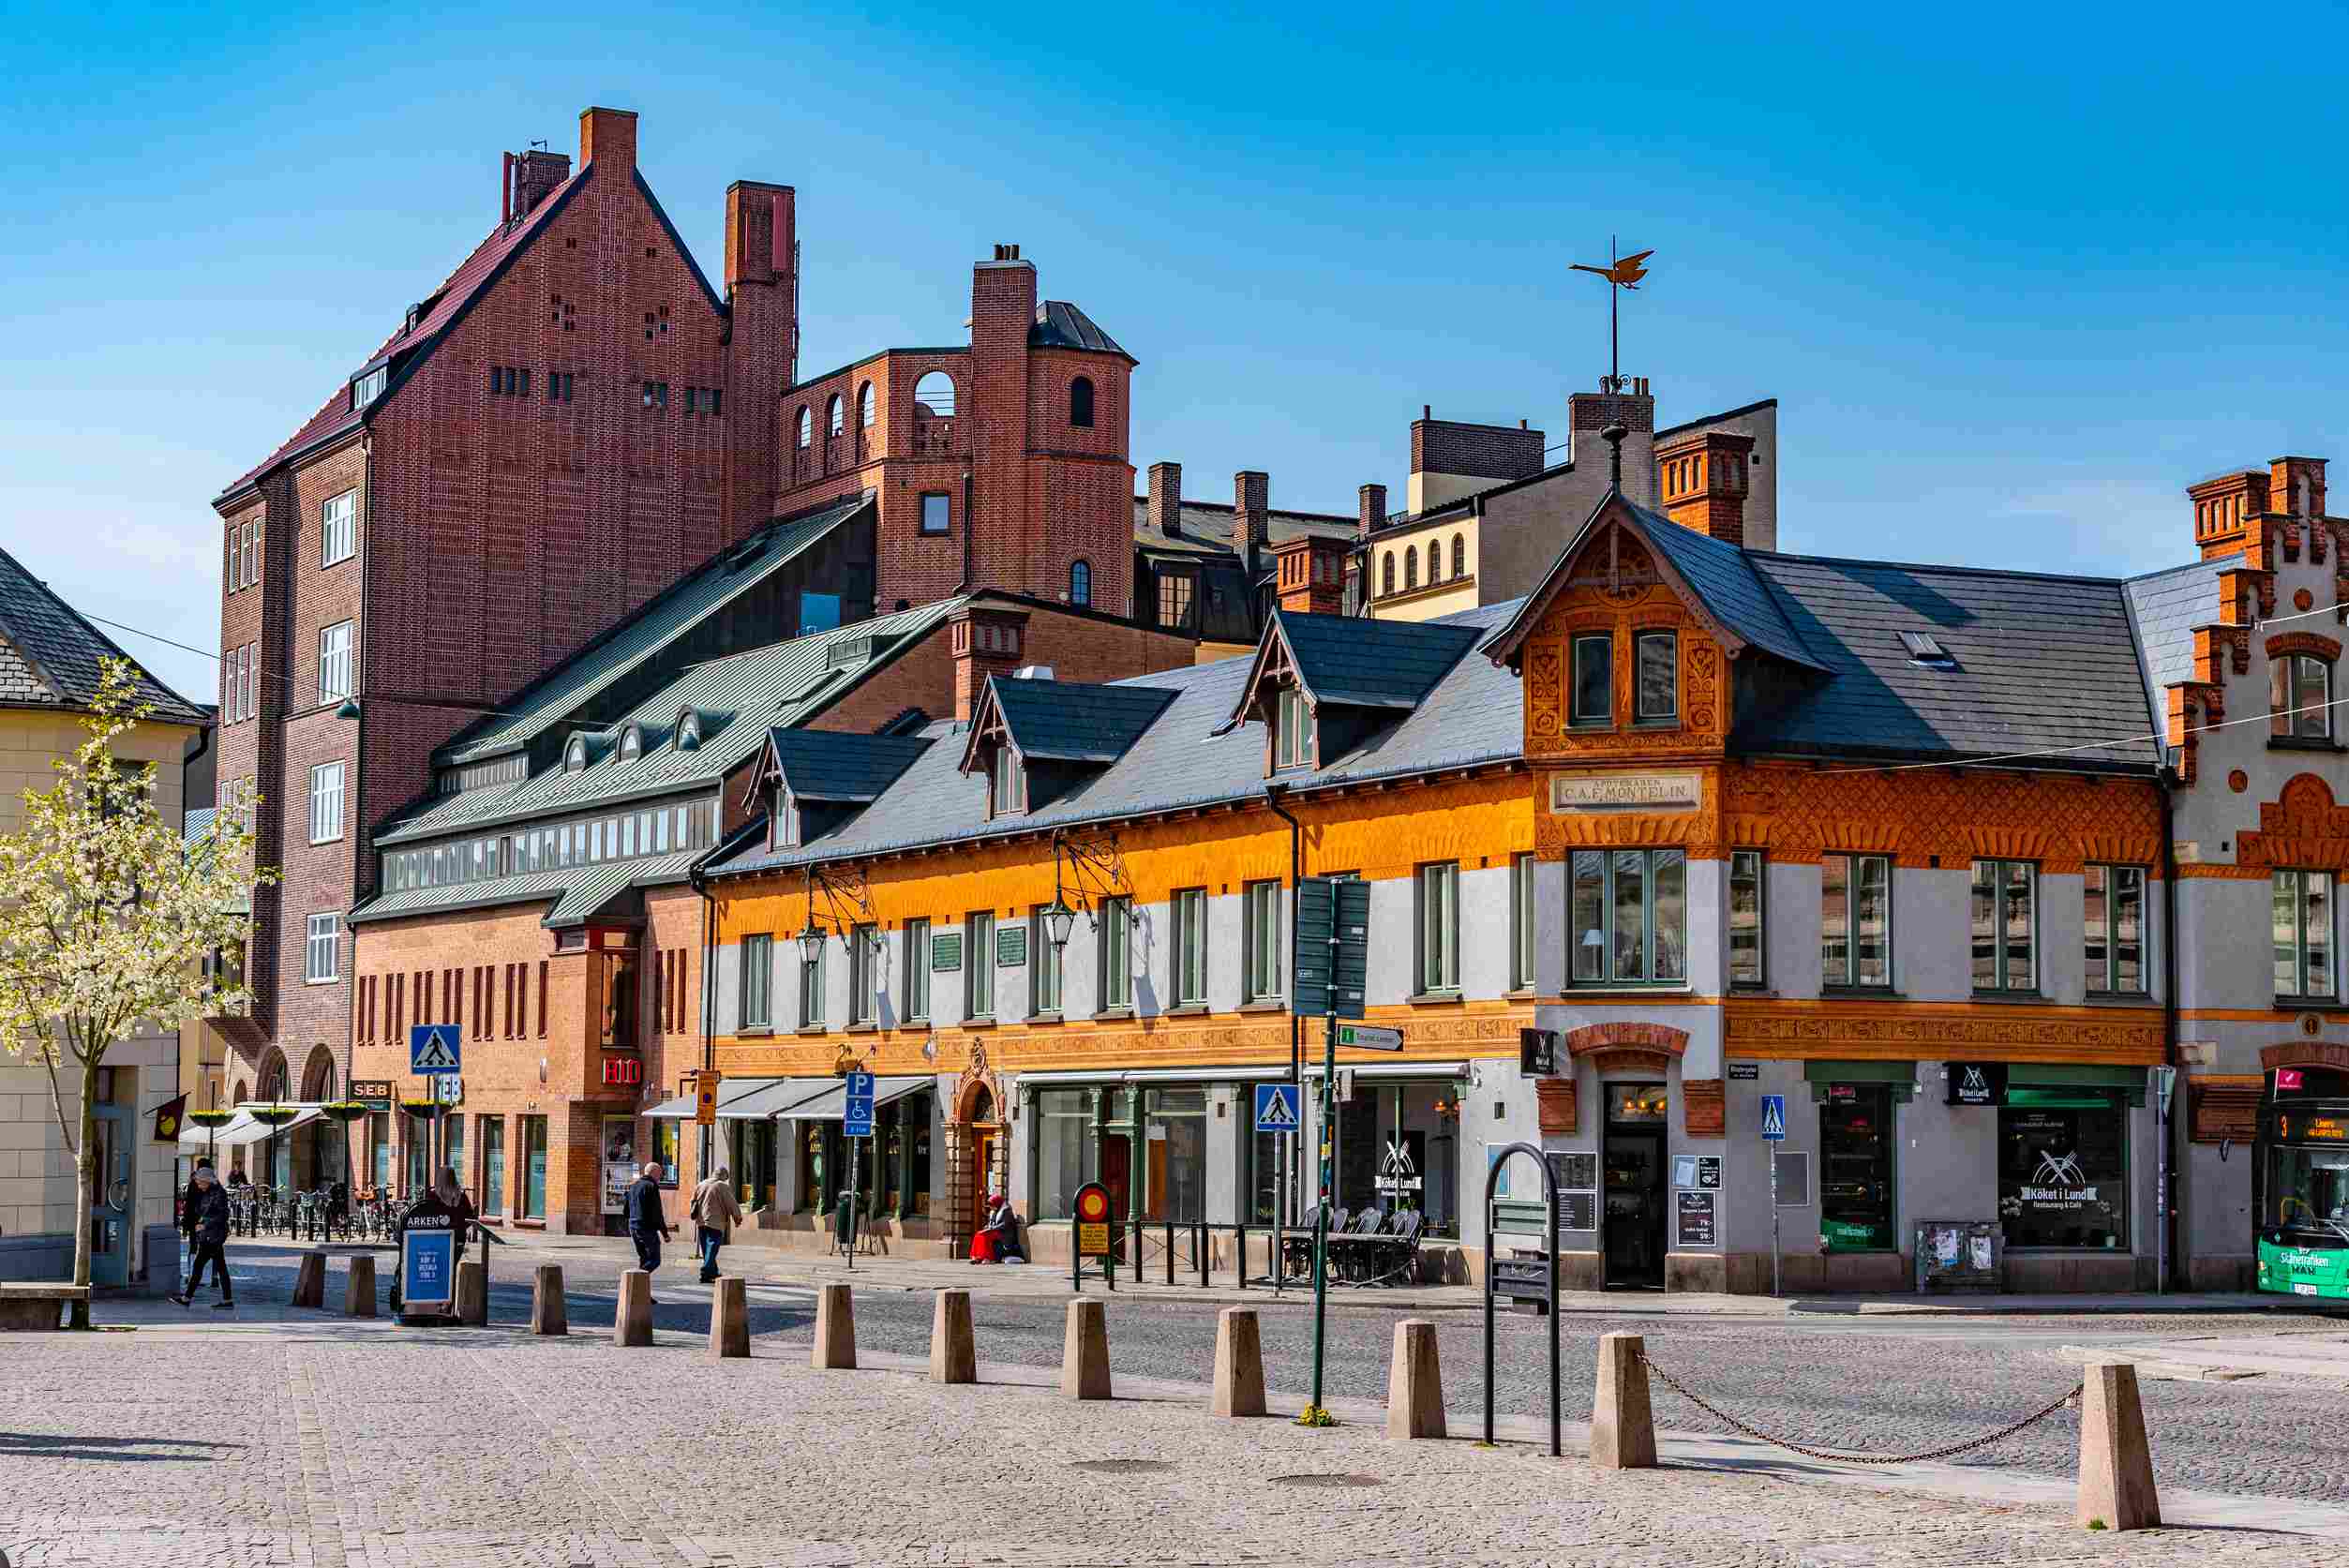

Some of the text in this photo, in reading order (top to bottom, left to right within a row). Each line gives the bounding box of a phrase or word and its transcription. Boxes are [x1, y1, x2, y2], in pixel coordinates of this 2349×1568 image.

[603, 1057, 641, 1083] BIO
[353, 1083, 388, 1097] SEB
[854, 1074, 868, 1094] P
[2281, 1115, 2288, 1138] 3
[2030, 1185, 2057, 1201] Köket
[2064, 1187, 2087, 1201] Lund
[407, 1217, 439, 1228] ARKEN
